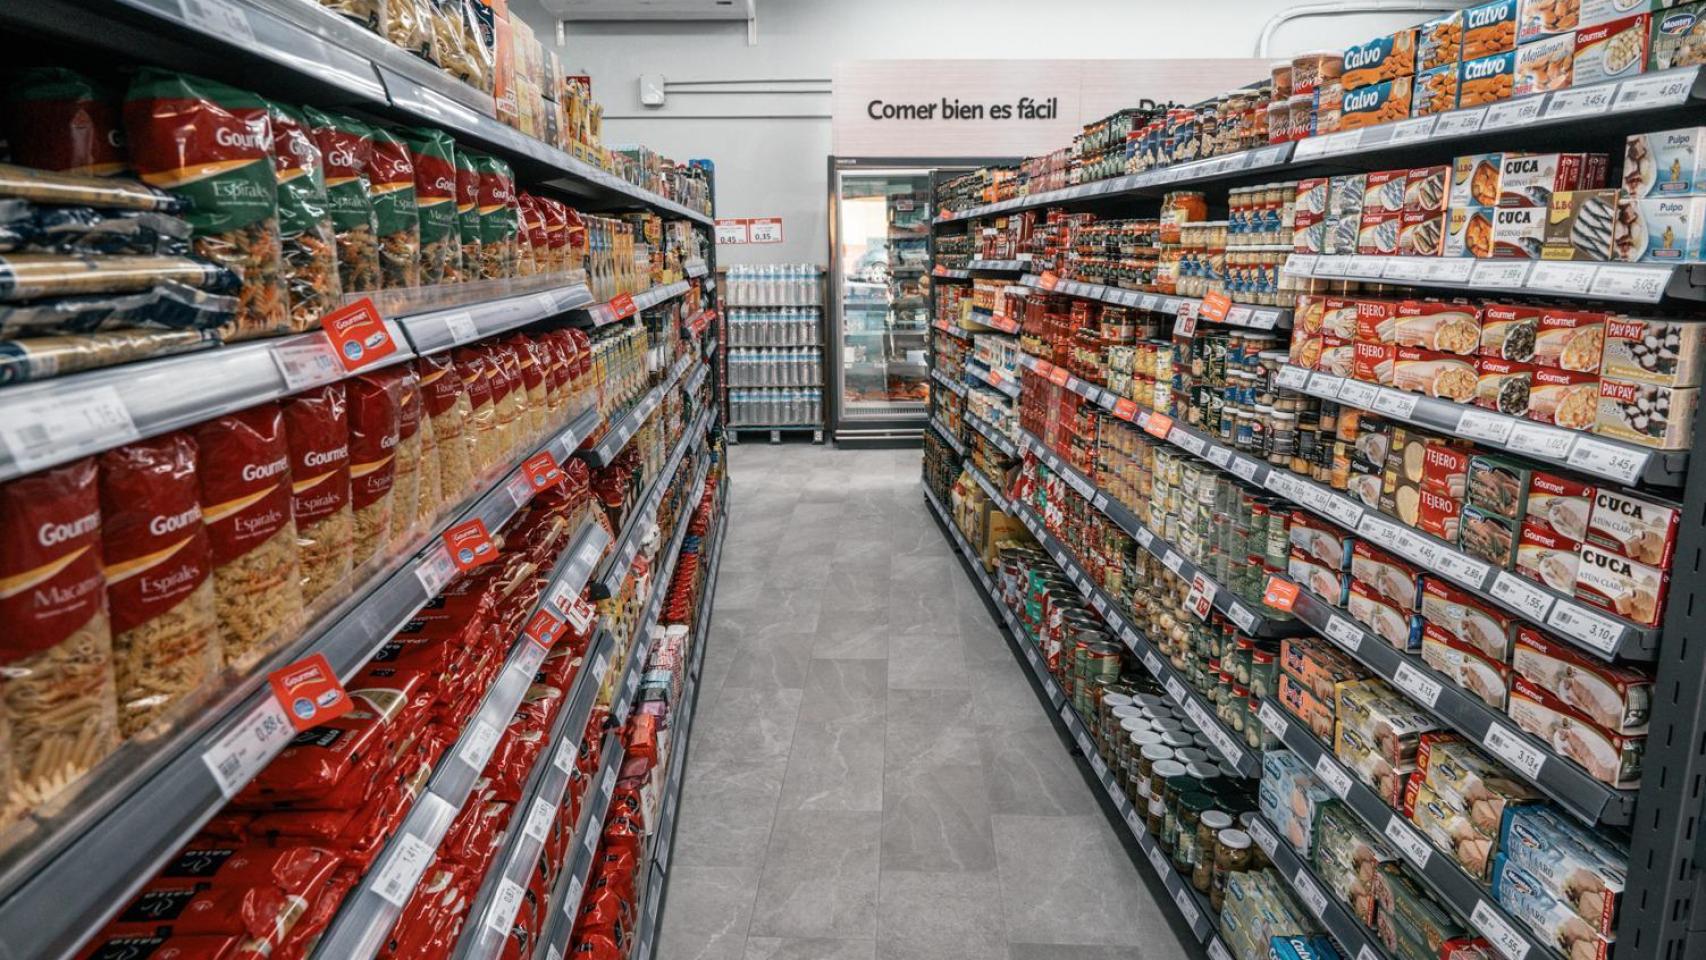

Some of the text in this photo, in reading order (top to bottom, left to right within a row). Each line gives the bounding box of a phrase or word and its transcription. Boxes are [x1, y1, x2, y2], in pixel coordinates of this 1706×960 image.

[1468, 5, 1508, 29] Calvo
[1577, 29, 1608, 44] Gourmet
[1344, 45, 1380, 69] Calvo
[1465, 58, 1505, 80] Calvo
[868, 97, 1057, 120] Comer bien es fácil
[1344, 88, 1378, 112] Calvo
[1668, 135, 1690, 145] Pulpo
[1506, 159, 1538, 174] CUCA
[1660, 203, 1683, 212] Pulpo
[1498, 211, 1531, 224] CUCA
[1358, 304, 1385, 316] TEJERO
[1399, 306, 1420, 315] Gourmet
[1488, 309, 1515, 320] Gourmet
[1543, 316, 1577, 327] Gourmet
[1610, 324, 1641, 337] PAY PAY
[1357, 344, 1384, 358] TEJERO
[1482, 361, 1509, 373] Gourmet
[1536, 371, 1570, 383] Gourmet
[1602, 384, 1633, 397] PAY PAY
[304, 445, 349, 467] Gourmet
[1427, 449, 1456, 469] TEJERO
[1609, 456, 1635, 472] 3,45€
[242, 457, 289, 482] Gourmet
[1534, 477, 1564, 495] Gourmet
[295, 492, 340, 512] Espirales
[1422, 491, 1452, 513] TEJERO
[1597, 495, 1643, 520] CUCA
[234, 509, 281, 533] Espirales
[1524, 529, 1555, 547] Gourmet
[1583, 550, 1632, 577] CUCA
[140, 564, 200, 594] Espirales
[1589, 624, 1615, 642] 3,10€
[1521, 633, 1547, 653] Gourmet
[1516, 682, 1543, 704] Gourmet
